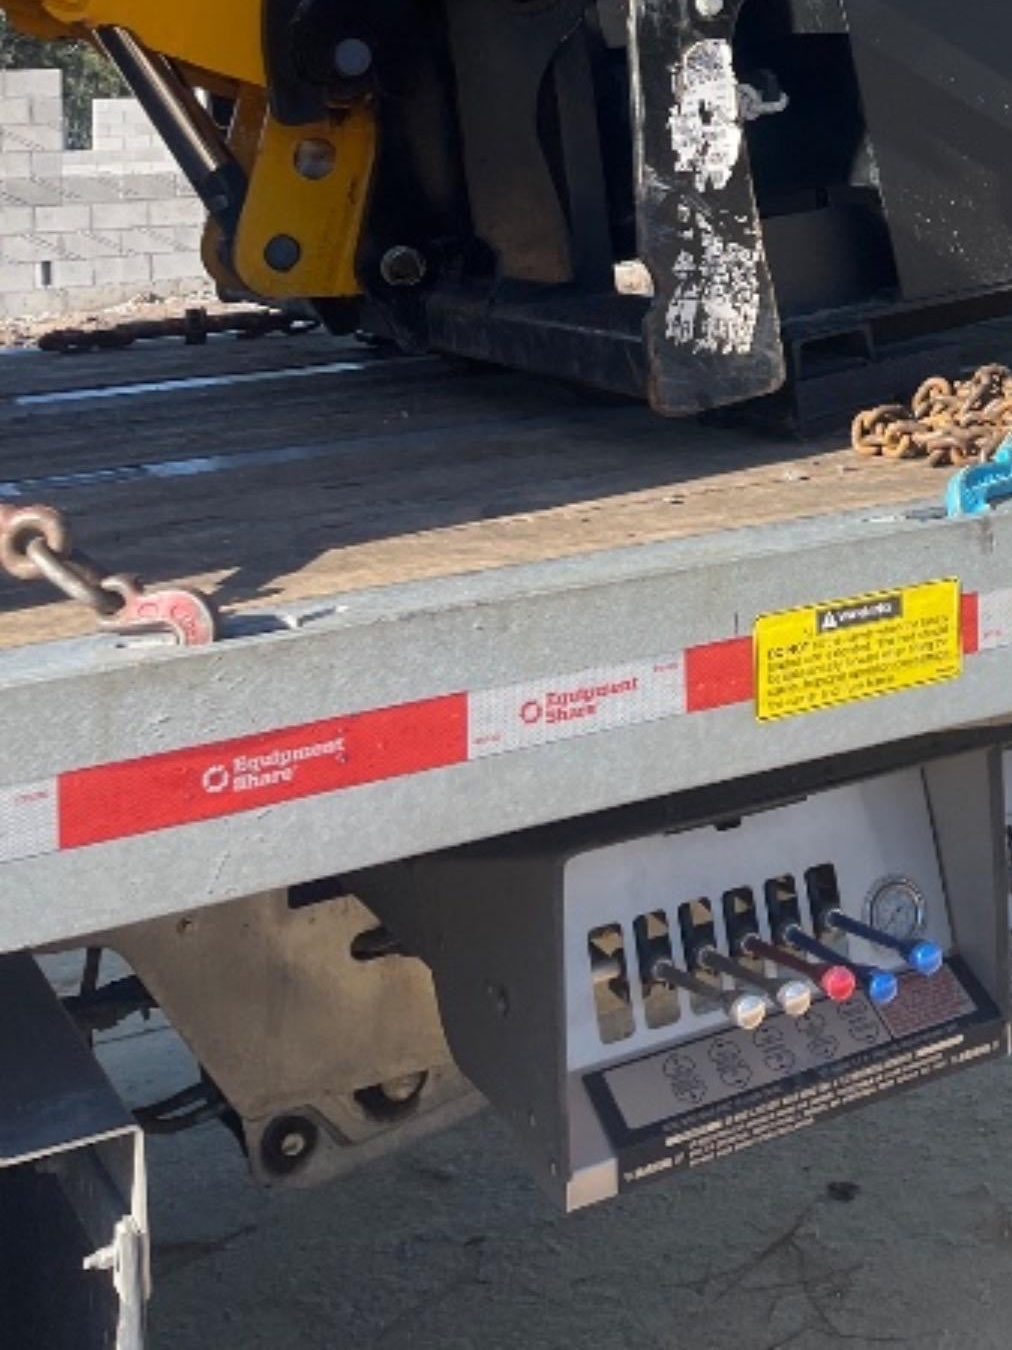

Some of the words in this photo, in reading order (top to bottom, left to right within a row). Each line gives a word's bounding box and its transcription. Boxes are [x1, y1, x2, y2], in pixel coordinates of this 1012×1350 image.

[545, 676, 639, 706] Equipment
[545, 704, 597, 723] Share
[233, 737, 345, 772] Equipment
[233, 766, 292, 792] Share
